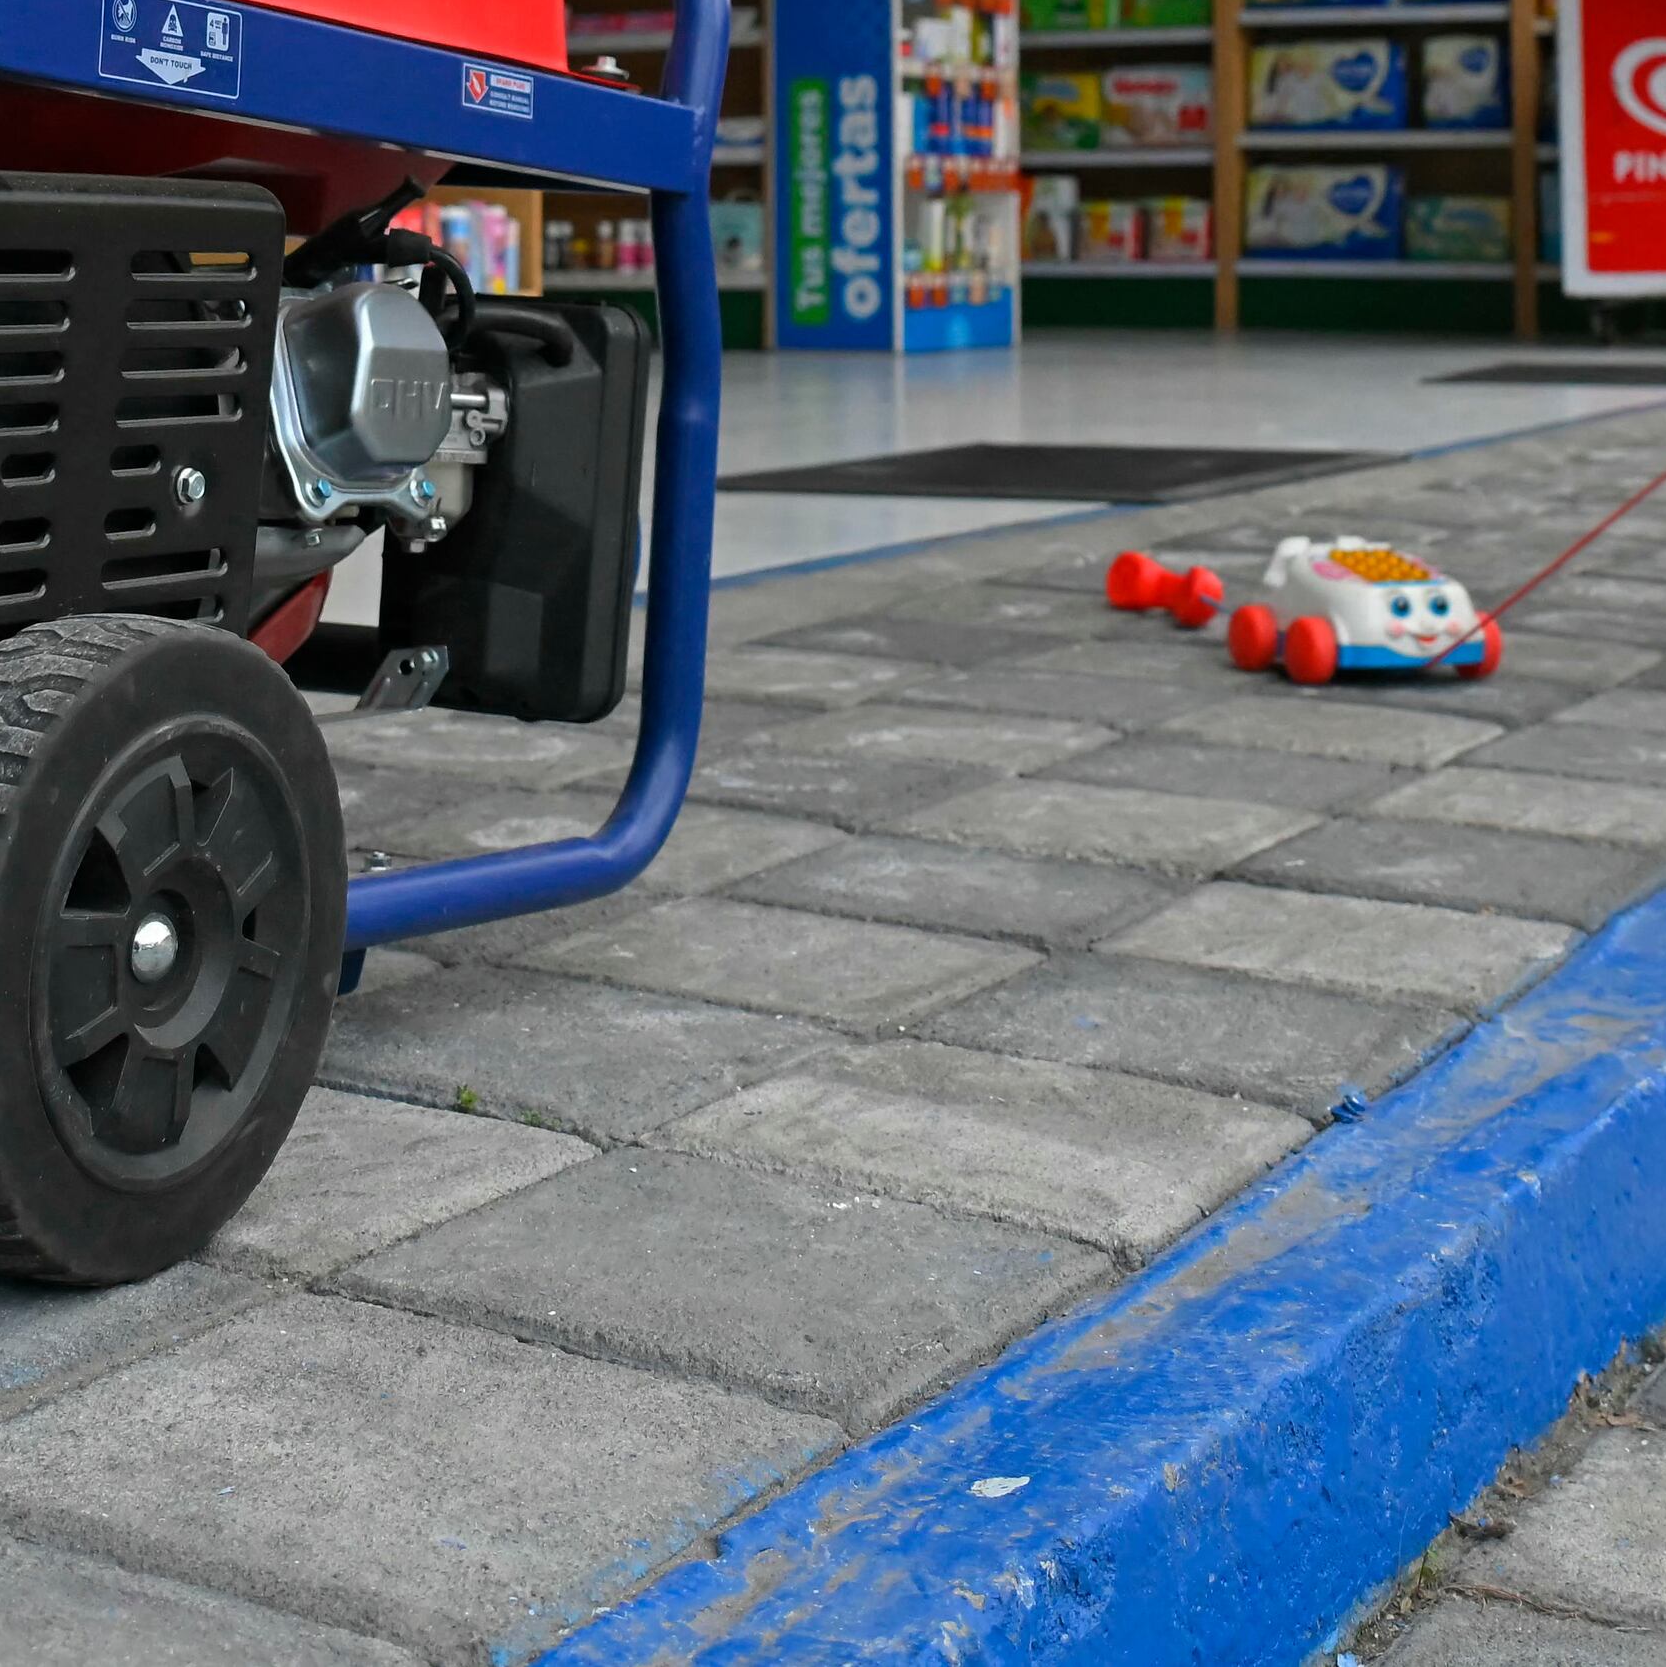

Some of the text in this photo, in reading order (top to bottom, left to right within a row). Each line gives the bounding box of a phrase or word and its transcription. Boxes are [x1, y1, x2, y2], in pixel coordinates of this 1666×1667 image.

[150, 56, 193, 70] DON'T TOUCH
[830, 73, 882, 320] ofertas
[371, 378, 449, 420] OHV
